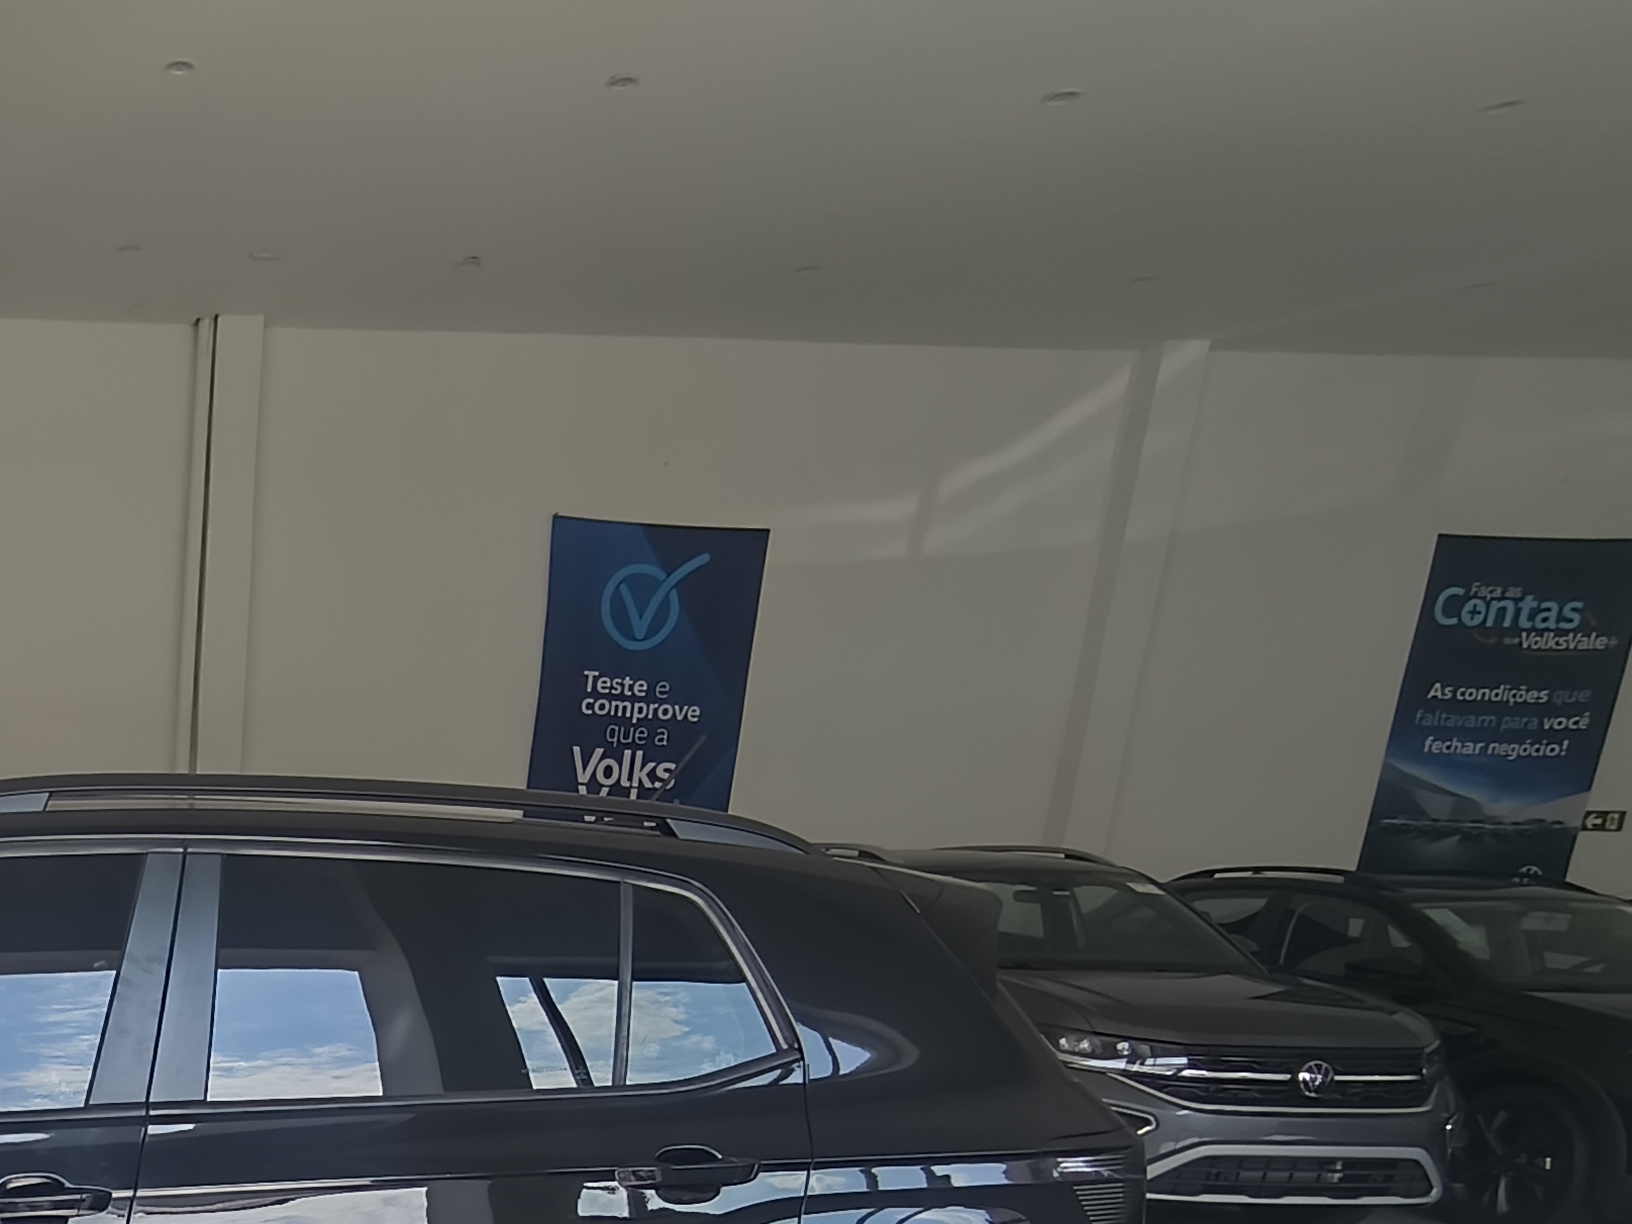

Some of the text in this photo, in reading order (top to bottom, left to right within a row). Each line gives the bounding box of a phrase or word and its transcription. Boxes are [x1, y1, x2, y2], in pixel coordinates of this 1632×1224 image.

[1469, 582, 1523, 601] Faça as
[1433, 586, 1585, 630] Contas
[582, 670, 670, 699] Teste e
[1426, 682, 1592, 706] As condições que
[580, 697, 701, 724] comprove
[1414, 708, 1591, 733] faltavam para você
[605, 723, 669, 748] que a
[1423, 735, 1570, 761] fechar negócio!
[572, 744, 677, 790] Volks
